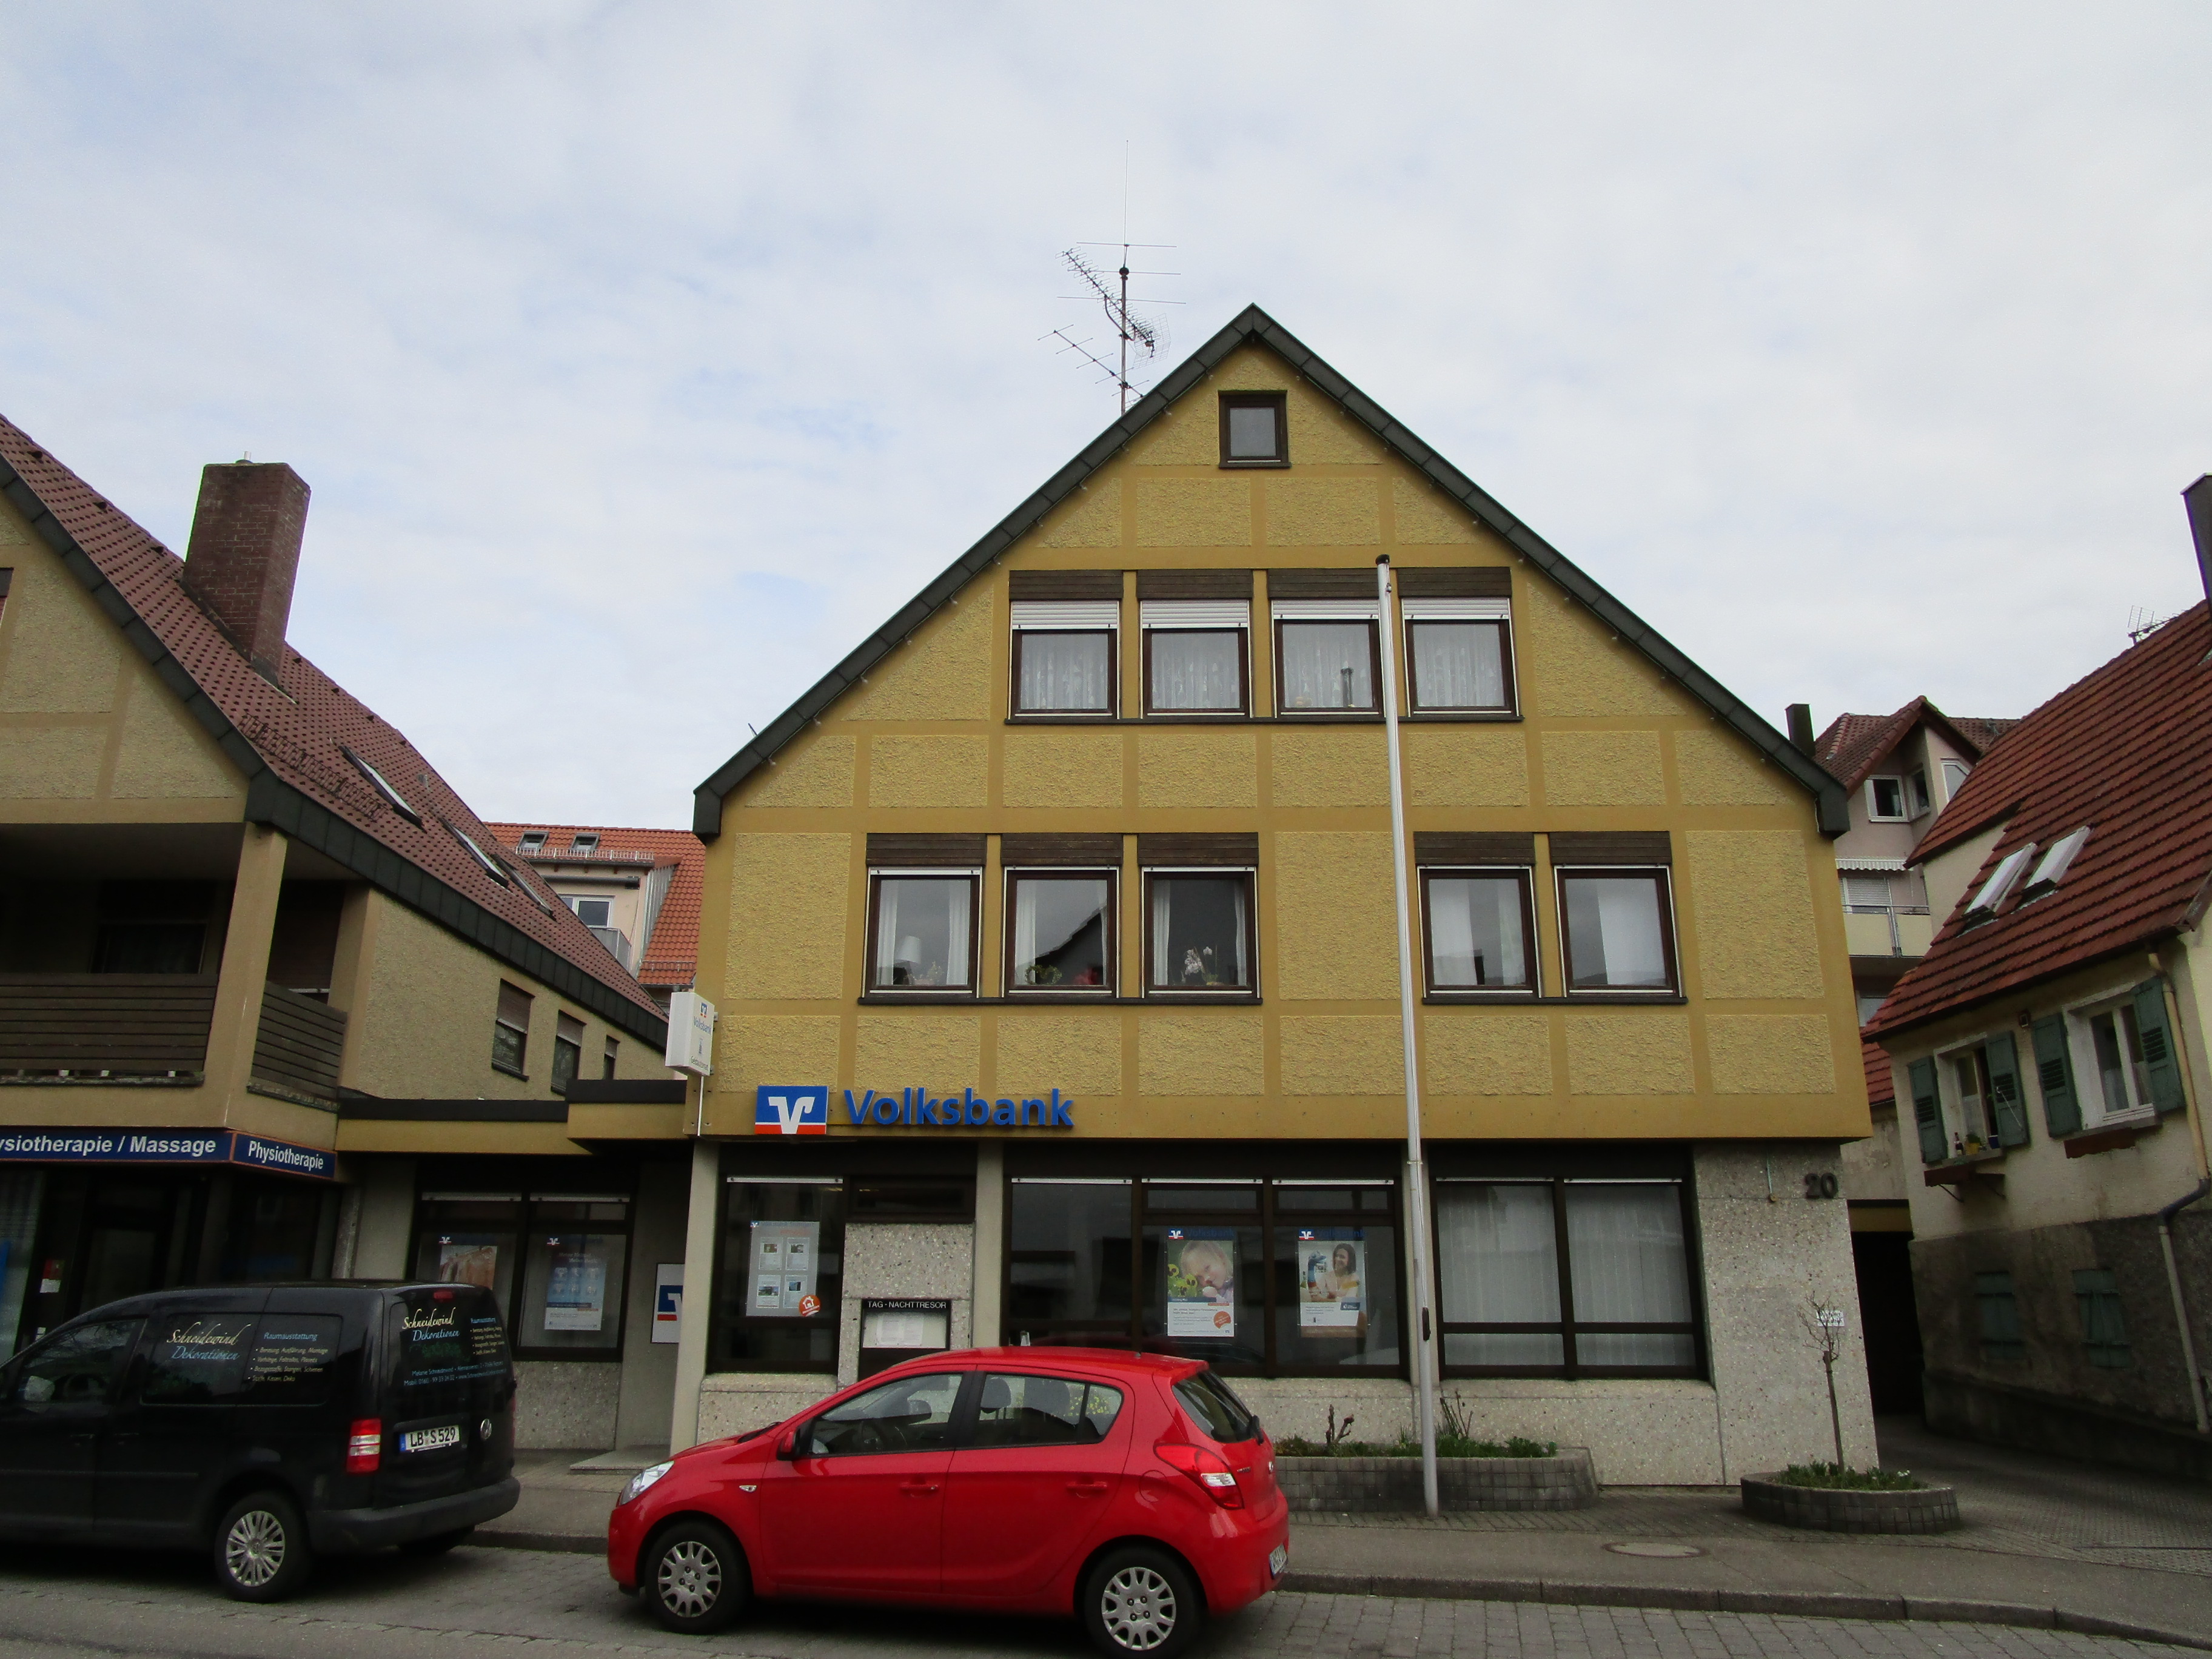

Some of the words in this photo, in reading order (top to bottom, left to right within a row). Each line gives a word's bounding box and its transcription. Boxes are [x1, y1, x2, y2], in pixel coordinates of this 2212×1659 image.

[694, 1016, 712, 1034] Volksbank
[843, 1087, 1074, 1126] Volksbank
[130, 1136, 216, 1157] Massage
[248, 1141, 324, 1171] Physiotherapie
[1805, 1173, 1838, 1199] 20
[402, 1307, 456, 1329] Schneidewind
[166, 1321, 251, 1346] Schneidewind
[264, 1332, 318, 1342] Raumausstattung
[412, 1326, 460, 1341] Dekorationen
[171, 1342, 241, 1360] Dekorationen
[411, 1432, 424, 1447] LB
[431, 1429, 437, 1444] S
[438, 1427, 455, 1442] 529
